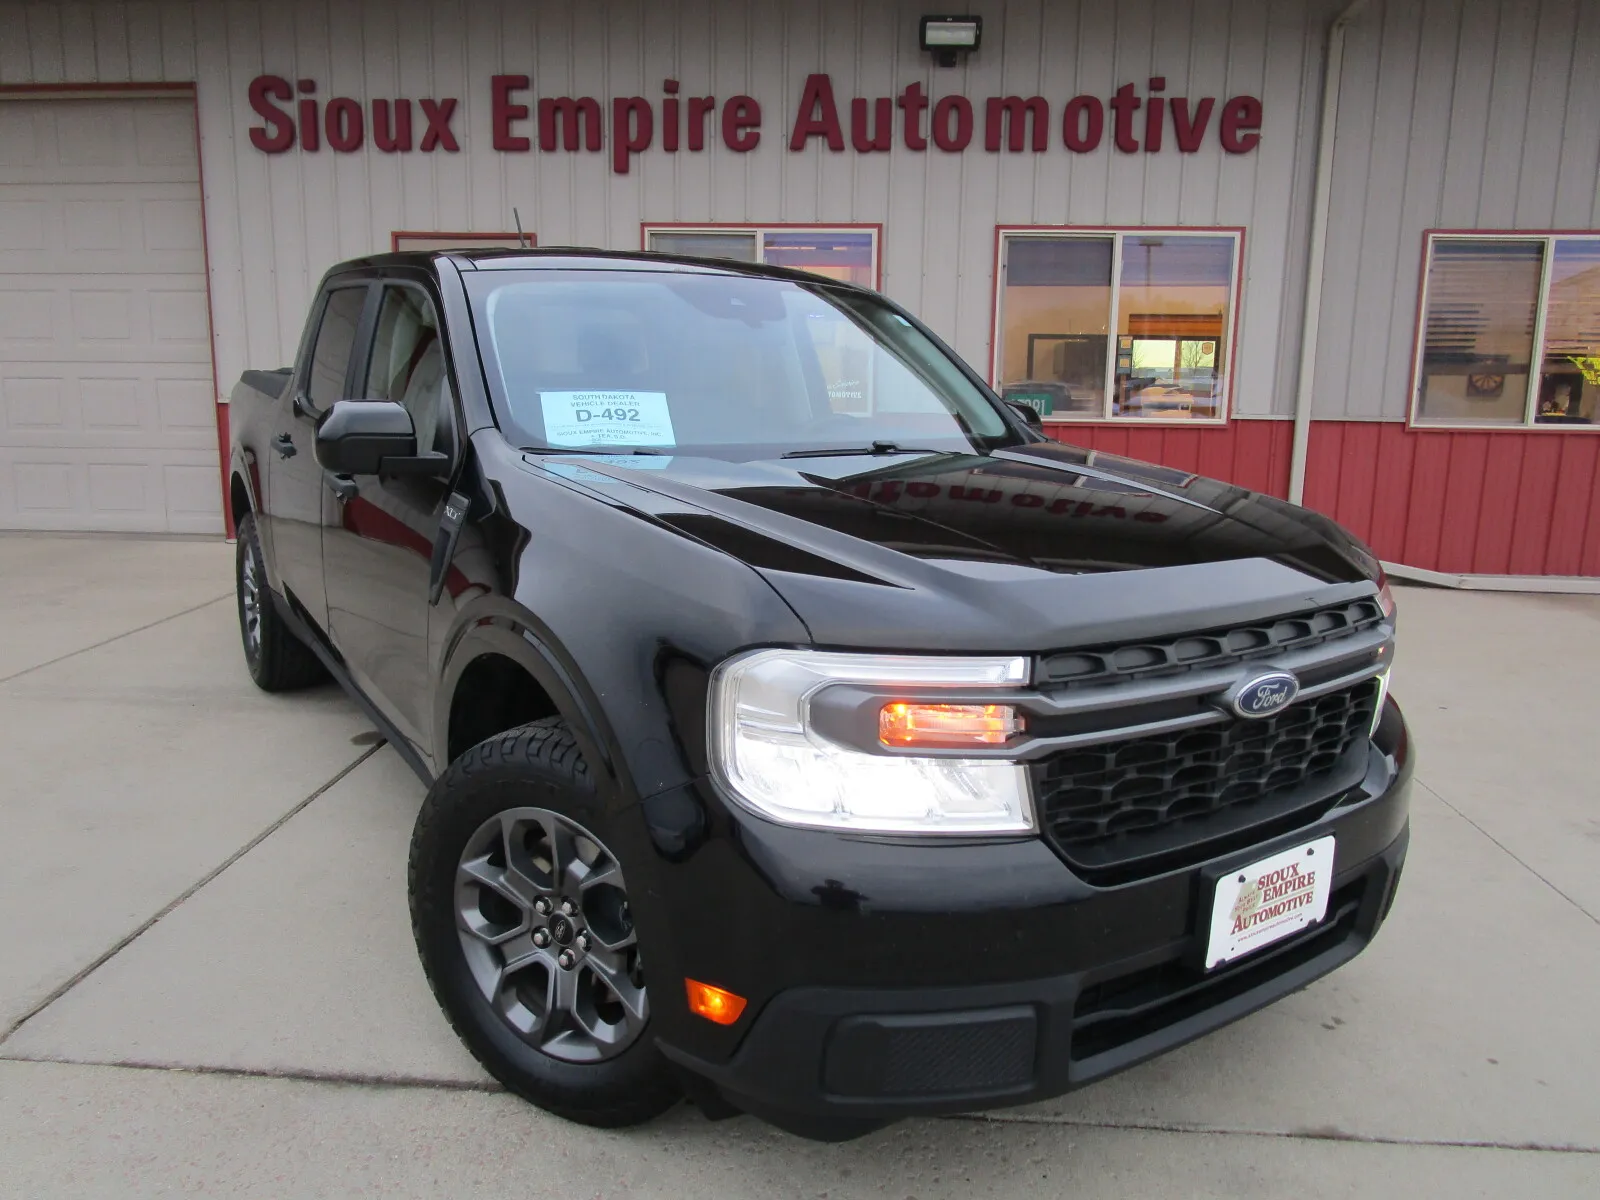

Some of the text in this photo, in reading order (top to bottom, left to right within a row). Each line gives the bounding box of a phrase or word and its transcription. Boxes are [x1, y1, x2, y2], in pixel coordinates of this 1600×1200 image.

[248, 74, 1263, 174] Sioux Empire Automotive
[576, 408, 641, 422] D-492
[1252, 682, 1288, 710] Ford
[1257, 862, 1300, 891] SIOUX
[1262, 872, 1316, 904] EMPIRE
[1230, 891, 1314, 936] AUTOMOTIVE
